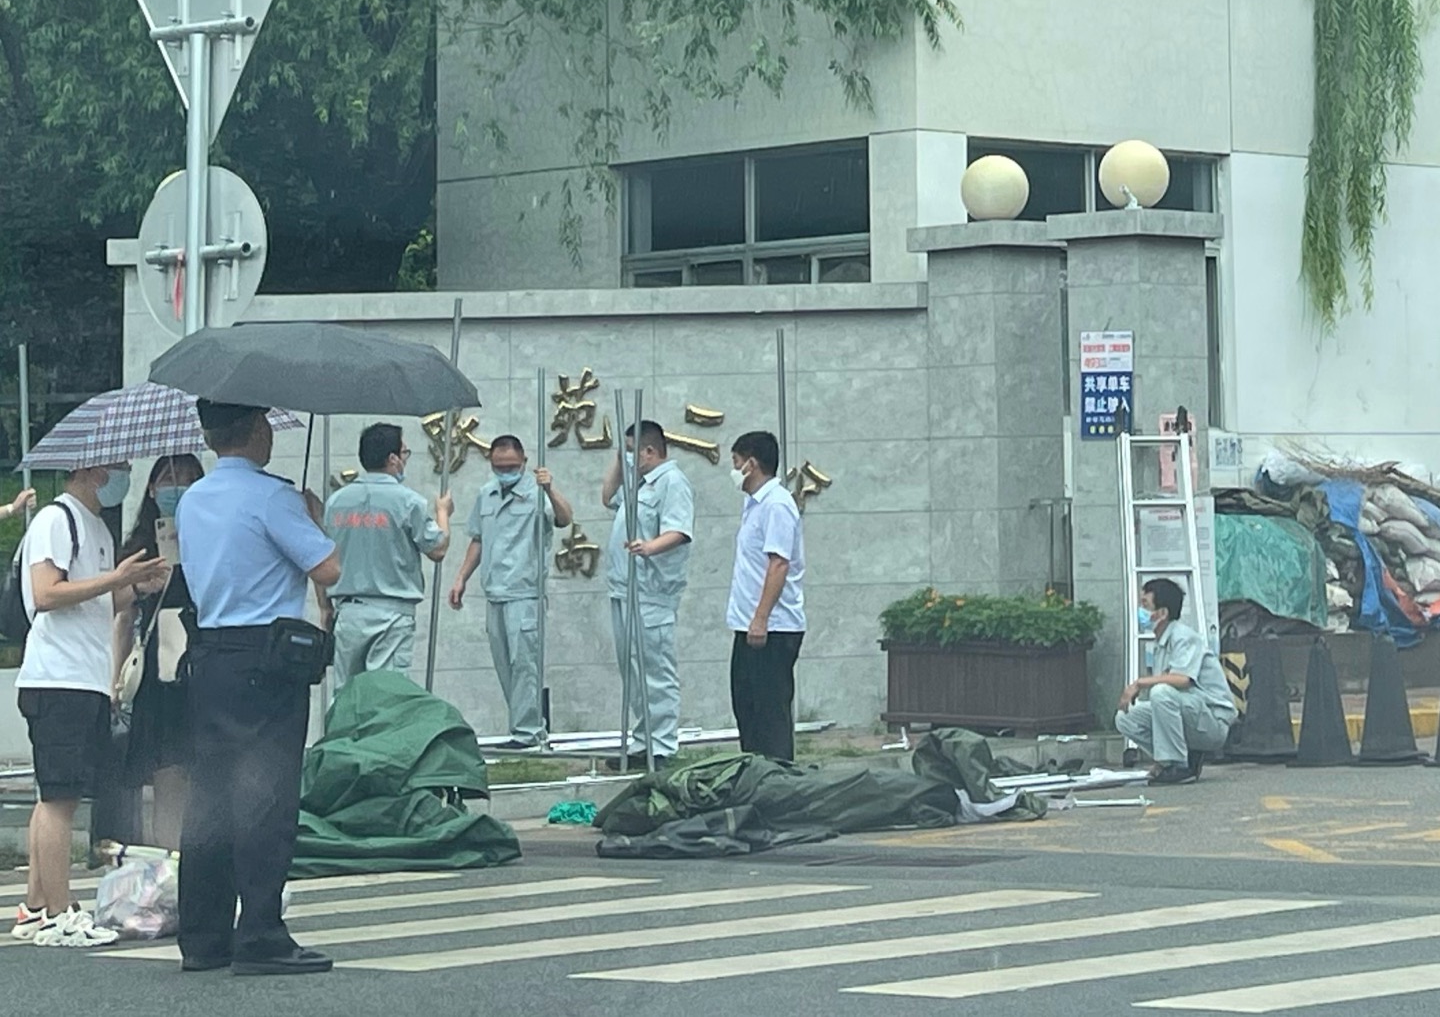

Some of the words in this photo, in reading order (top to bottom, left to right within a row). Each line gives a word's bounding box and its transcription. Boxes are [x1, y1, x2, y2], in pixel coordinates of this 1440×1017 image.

[1084, 375, 1131, 392] 共享单车
[1084, 396, 1130, 413] 禁止驶入
